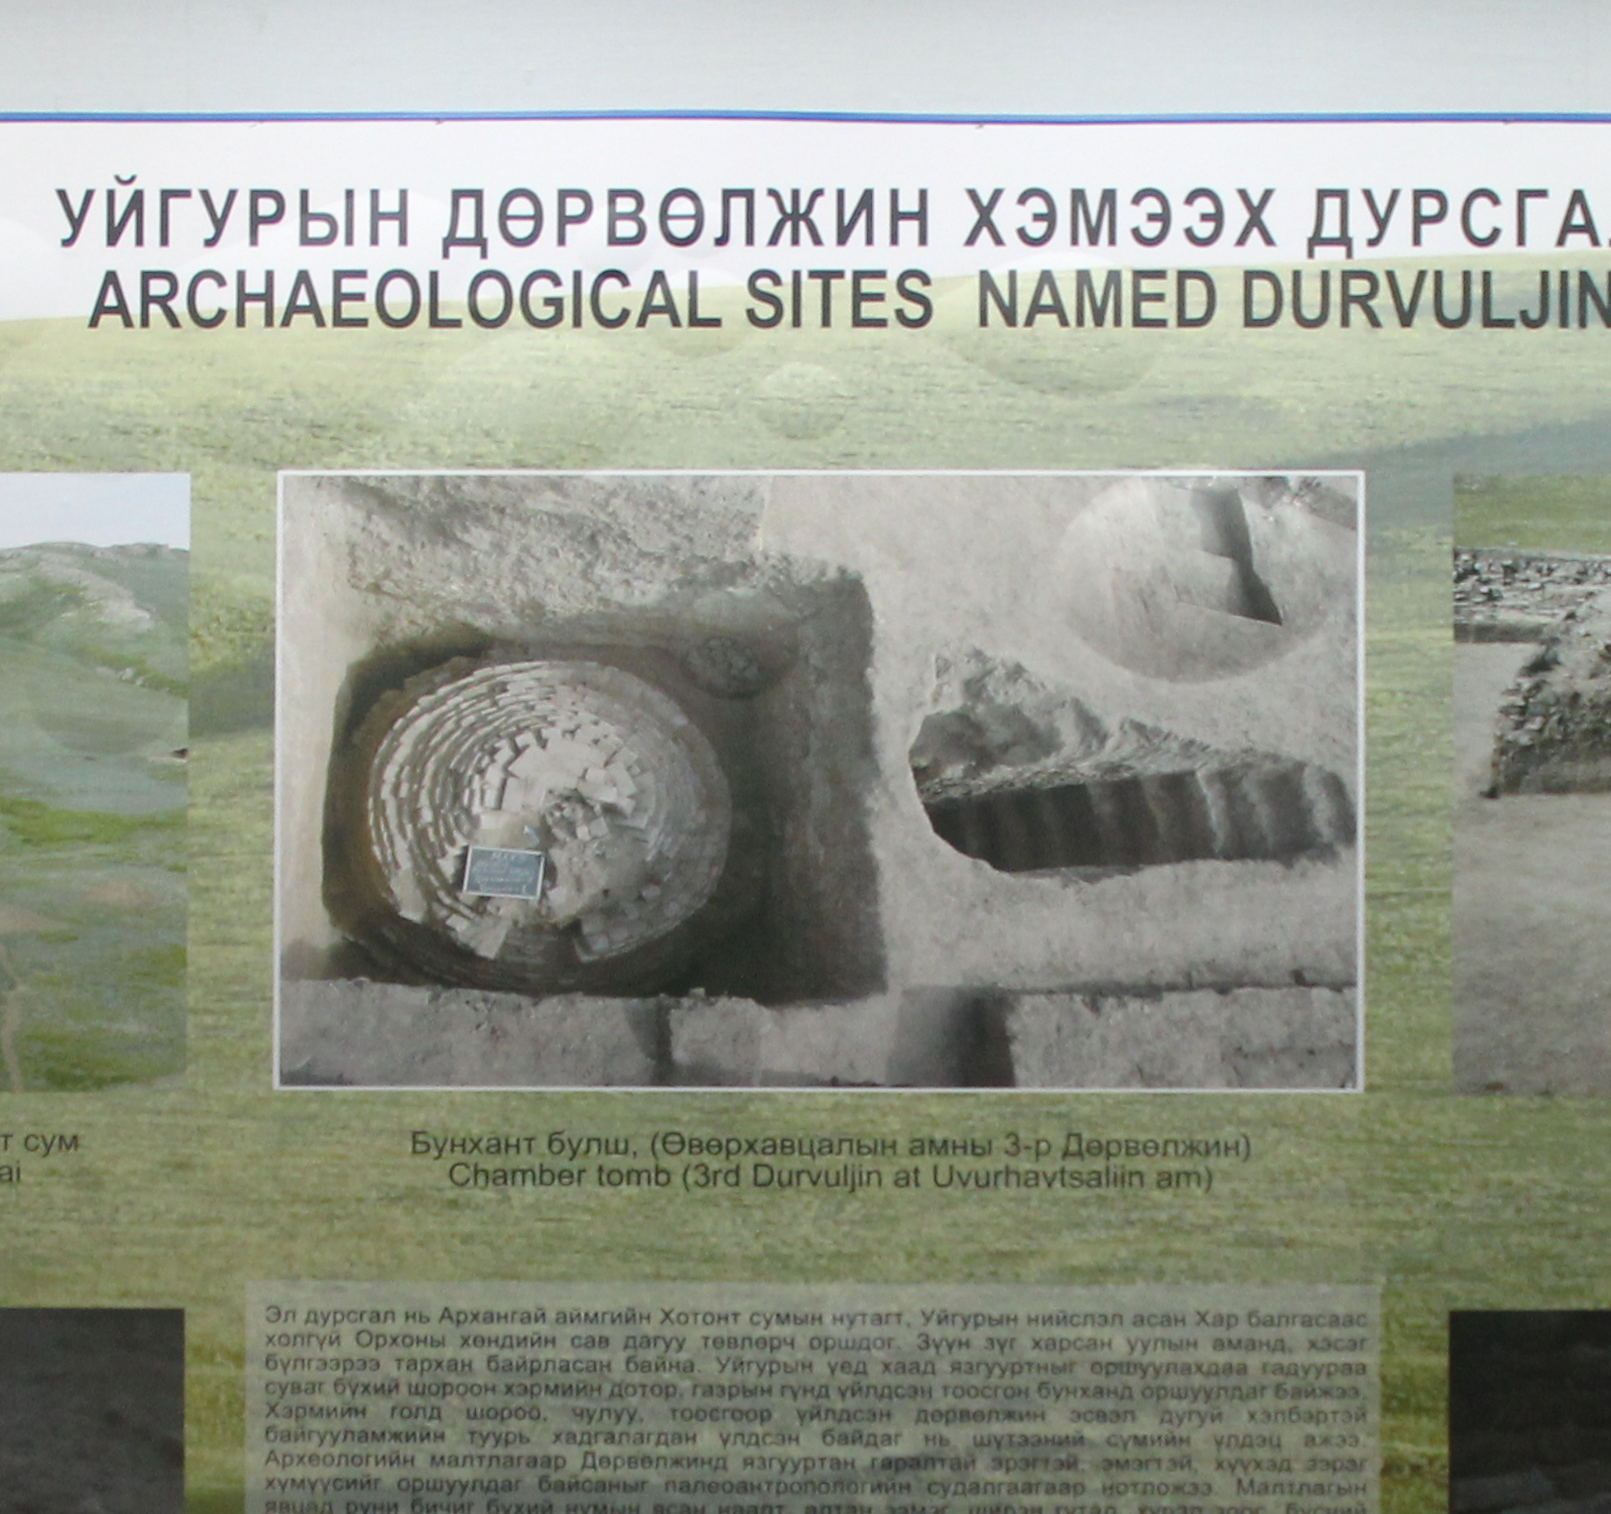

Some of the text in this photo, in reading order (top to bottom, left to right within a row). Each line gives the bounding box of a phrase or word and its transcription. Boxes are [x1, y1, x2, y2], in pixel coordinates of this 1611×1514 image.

[55, 178, 409, 247] УЙГУРЫН
[444, 189, 931, 259] ДӨРВӨЛЖИН
[966, 189, 1277, 247] ХЭМЭЭХ
[88, 270, 723, 329] ARCHAEOLOGICAL
[747, 269, 935, 329] SITES
[980, 270, 1220, 328] NAMED
[24, 1132, 81, 1158] сум
[412, 1131, 537, 1163] Бунхант
[546, 1131, 638, 1163] булш,
[907, 1137, 993, 1158] амны
[1004, 1131, 1052, 1163] 3-р
[1062, 1131, 1252, 1163] Дөрвөлжин)
[449, 1165, 588, 1190] Chamber
[596, 1165, 672, 1190] tomb
[683, 1165, 741, 1195] (3rd
[752, 1165, 883, 1195] Durvuljin
[892, 1165, 922, 1190] at
[1157, 1165, 1216, 1195] am)
